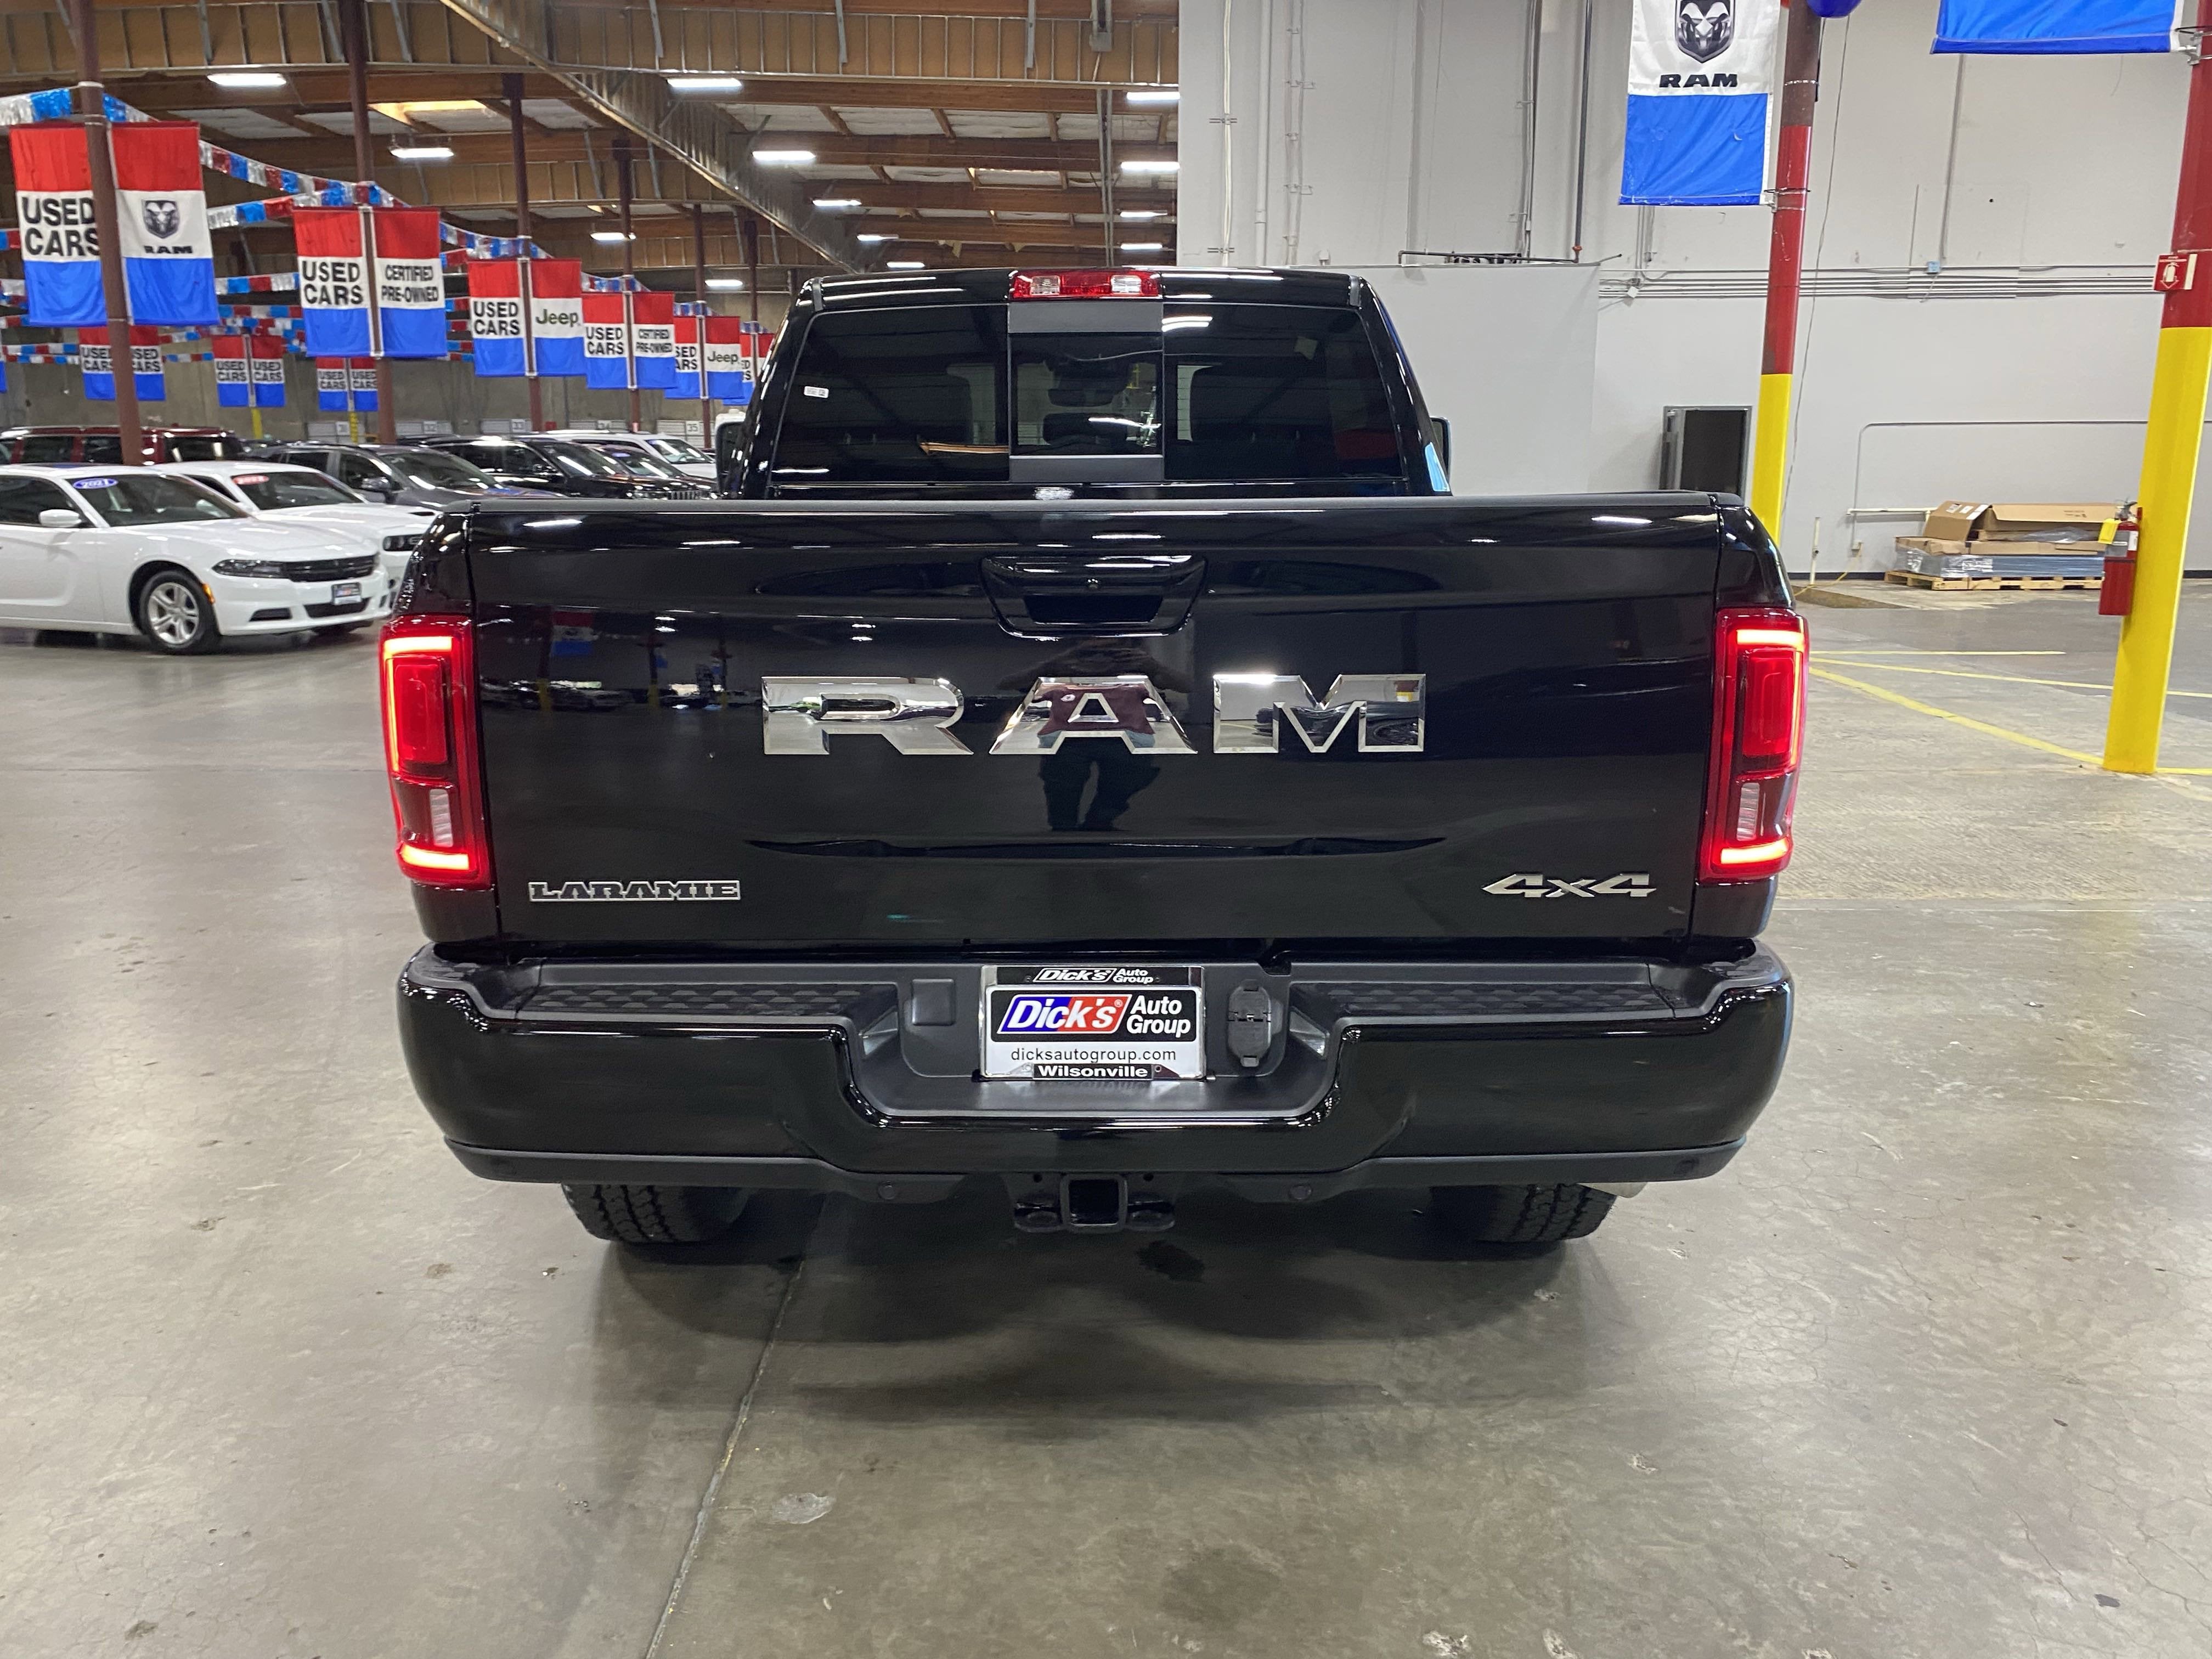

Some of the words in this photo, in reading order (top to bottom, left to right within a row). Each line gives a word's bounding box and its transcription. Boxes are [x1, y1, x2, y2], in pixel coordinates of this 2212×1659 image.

[1659, 73, 1738, 88] RAM
[22, 197, 94, 225] USED
[25, 228, 99, 256] CARS
[144, 246, 193, 254] RAM
[302, 261, 360, 282] USED
[386, 265, 433, 281] CERTIFIED
[304, 284, 363, 304] CARS
[382, 286, 438, 302] PRE-OWNED
[474, 302, 518, 317] USED
[535, 309, 578, 328] Jeep
[474, 319, 520, 335] CARS
[586, 327, 622, 340] USED
[587, 342, 623, 354] CARS
[676, 359, 697, 370] ARS
[708, 351, 738, 364] Jeep
[217, 361, 244, 370] USED
[254, 361, 280, 370] USED
[219, 371, 246, 381] CARS
[255, 371, 282, 381] CARS
[761, 674, 1425, 755] RAM
[528, 880, 741, 901] LARAMIE
[1482, 873, 1657, 898] 4x4
[1040, 969, 1108, 981] Dick's
[1113, 975, 1154, 984] Group
[1115, 968, 1148, 977] Auto
[1130, 995, 1182, 1015] Auto
[1007, 998, 1116, 1029] Dick's
[1127, 1015, 1191, 1038] Group
[1011, 1048, 1176, 1063] dicksautogroup.com
[1038, 1065, 1148, 1077] Wilsonville
